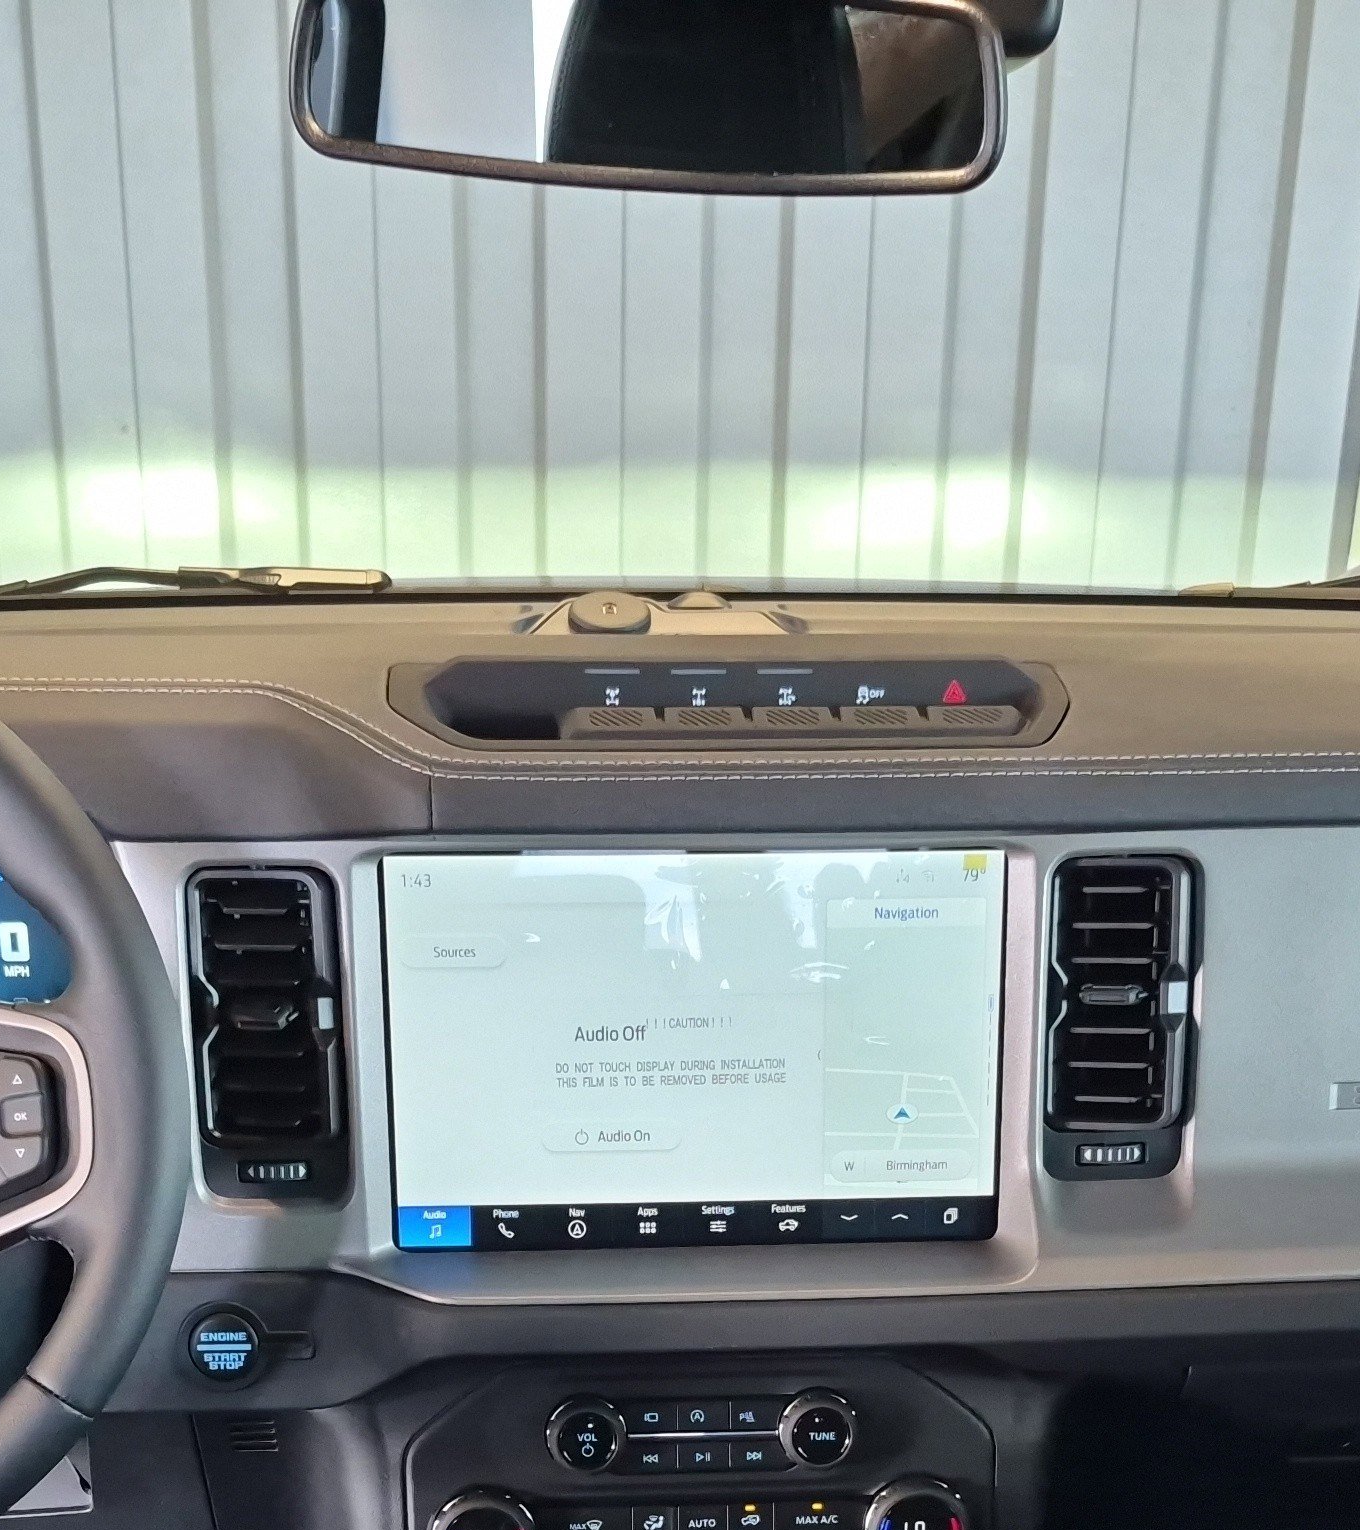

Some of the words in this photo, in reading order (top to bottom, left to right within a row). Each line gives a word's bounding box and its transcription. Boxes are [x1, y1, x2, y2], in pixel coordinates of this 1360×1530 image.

[870, 689, 885, 698] OFF
[402, 874, 431, 887] 1:43
[875, 907, 938, 921] Navigation
[434, 947, 475, 958] Sources
[3, 965, 30, 977] MPH
[575, 1026, 619, 1042] Audio
[623, 1025, 646, 1042] Off
[556, 1063, 569, 1074] DO
[575, 1063, 593, 1073] NOT
[599, 1062, 631, 1073] TOUCH
[636, 1061, 675, 1072] DISPLAY
[681, 1060, 715, 1071] DURING
[721, 1059, 785, 1070] INSTALLATION
[557, 1077, 577, 1088] THIS
[583, 1077, 604, 1087] FILM
[610, 1077, 618, 1087] IS
[624, 1076, 636, 1086] TO
[642, 1076, 655, 1086] BE
[660, 1075, 706, 1085] REMOVED
[712, 1074, 749, 1084] BEFORE
[755, 1073, 786, 1083] USAGE
[14, 1112, 27, 1121] OK
[598, 1131, 631, 1142] Audio
[634, 1130, 651, 1142] On
[844, 1162, 854, 1171] W
[886, 1160, 947, 1171] Birmingham
[569, 1209, 585, 1218] Nav
[637, 1207, 658, 1217] Apps
[701, 1205, 735, 1216] Settings
[771, 1204, 806, 1213] Features
[423, 1210, 446, 1219] Audio
[493, 1209, 519, 1219] Phone
[200, 1332, 247, 1341] ENGINE
[204, 1353, 247, 1362] START
[209, 1362, 243, 1370] STOP
[577, 1433, 598, 1442] VOL
[809, 1432, 836, 1441] TUNE
[688, 1518, 716, 1528] AUTO
[796, 1515, 818, 1525] MAX
[821, 1514, 838, 1524] A/C
